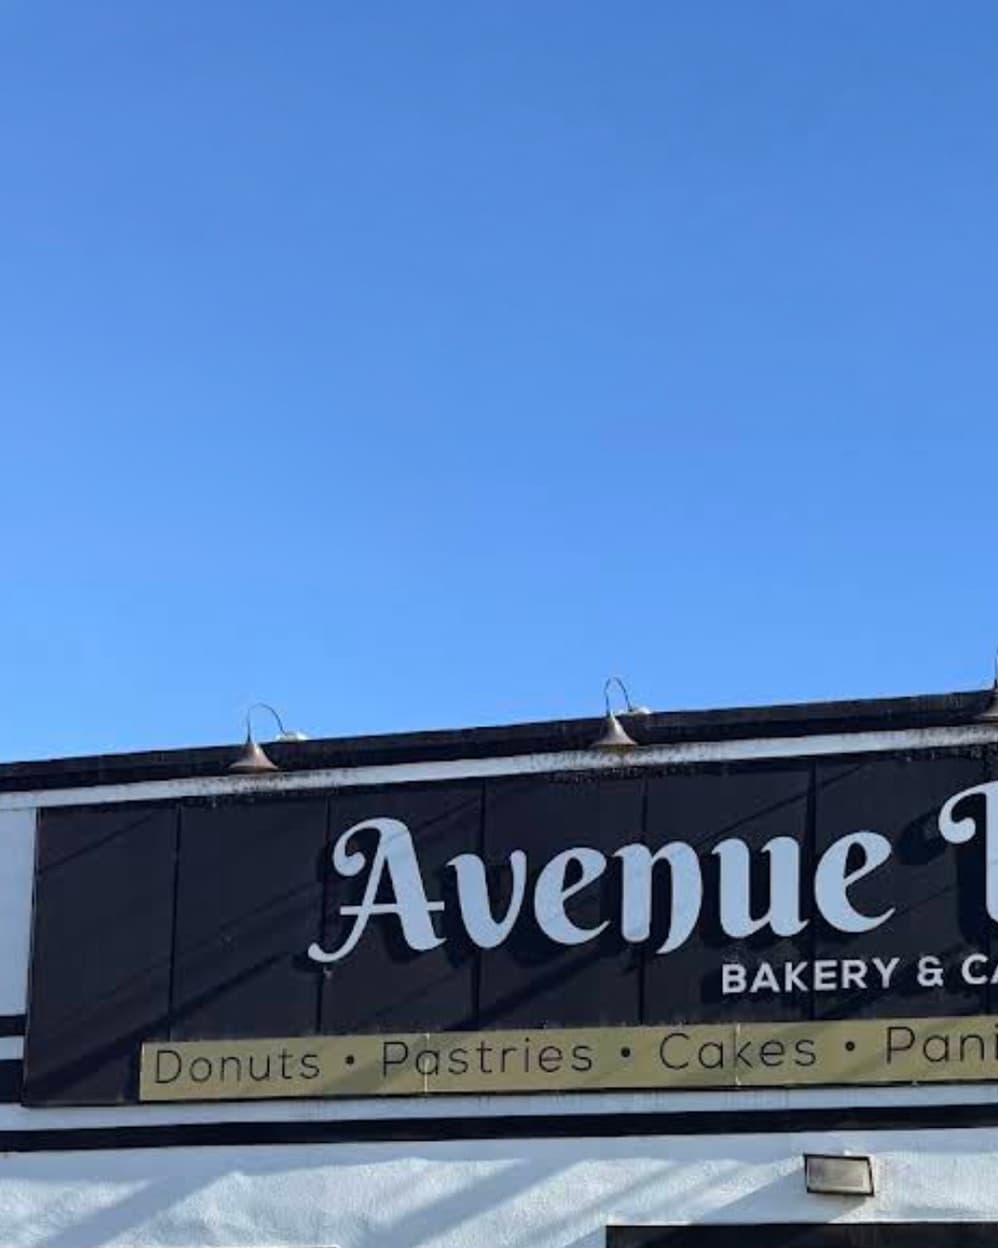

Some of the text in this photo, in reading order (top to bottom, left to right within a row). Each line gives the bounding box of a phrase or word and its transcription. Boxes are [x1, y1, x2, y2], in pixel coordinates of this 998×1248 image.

[308, 818, 894, 963] Avenue
[722, 957, 900, 995] BAKERY
[916, 956, 944, 988] &
[154, 1047, 322, 1084] Donuts
[382, 1037, 594, 1077] Pastries
[659, 1032, 817, 1070] Cakes
